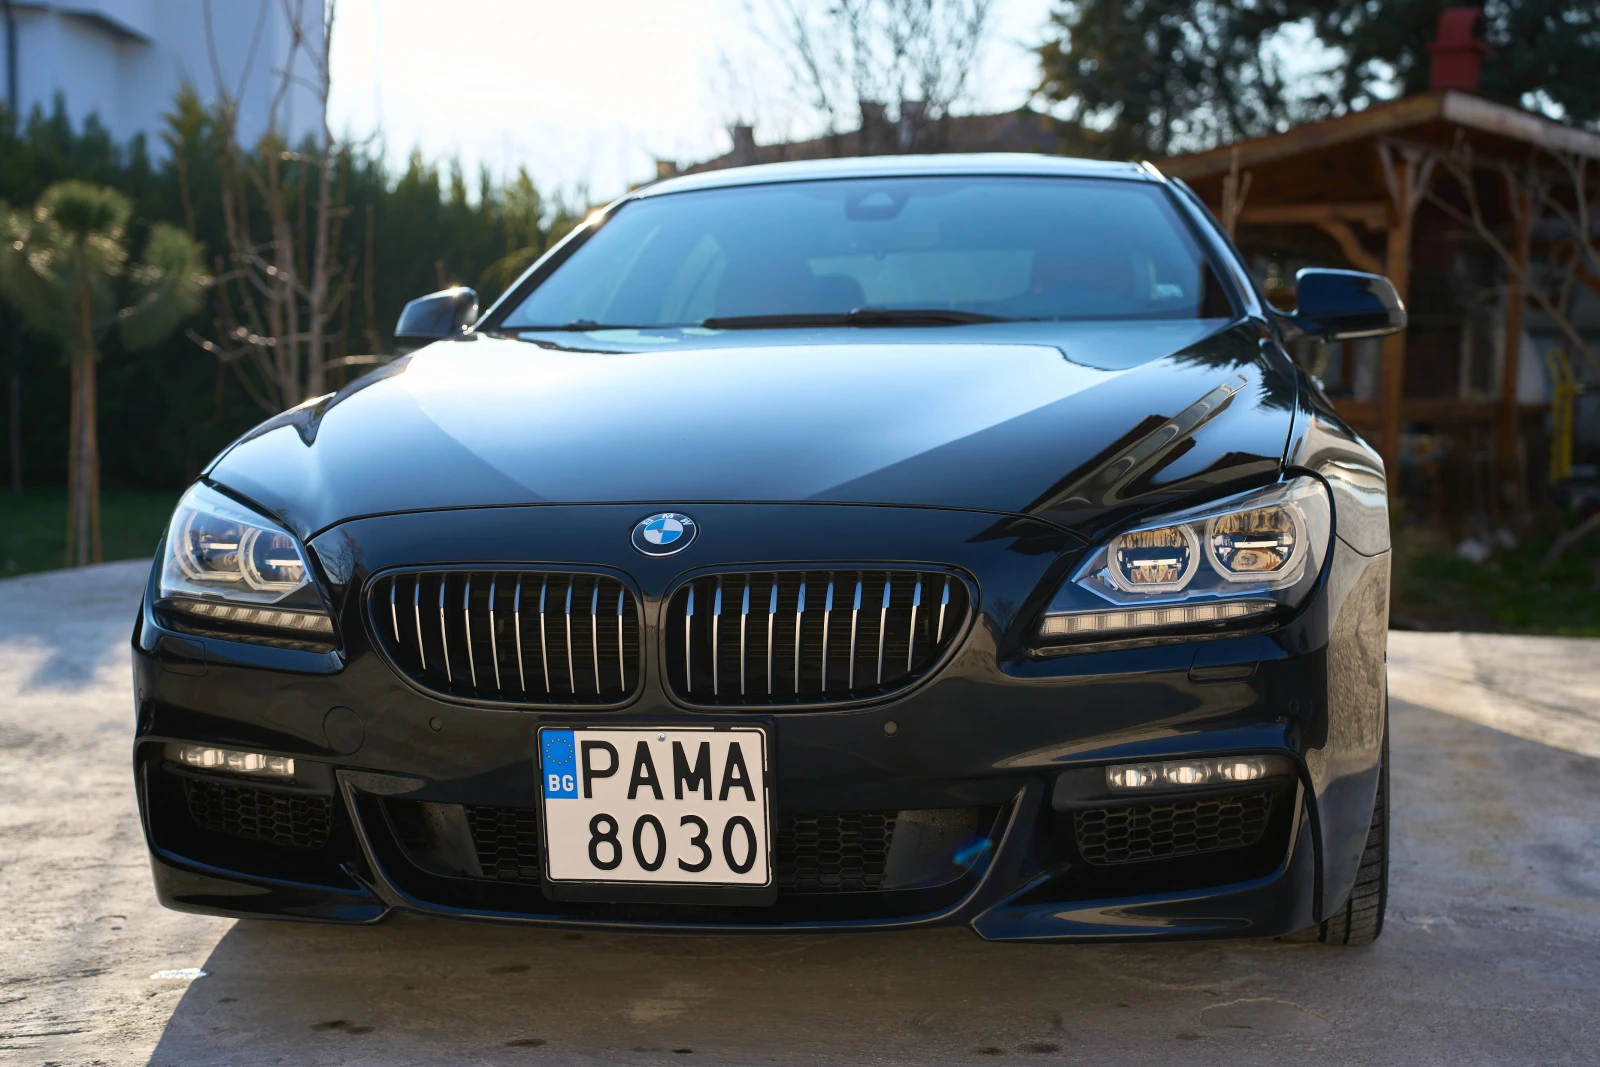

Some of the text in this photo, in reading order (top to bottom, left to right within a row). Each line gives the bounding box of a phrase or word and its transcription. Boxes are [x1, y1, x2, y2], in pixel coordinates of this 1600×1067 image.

[641, 513, 693, 526] BMW
[548, 774, 574, 792] BG
[580, 740, 756, 801] PAMA
[587, 812, 758, 875] 8030
